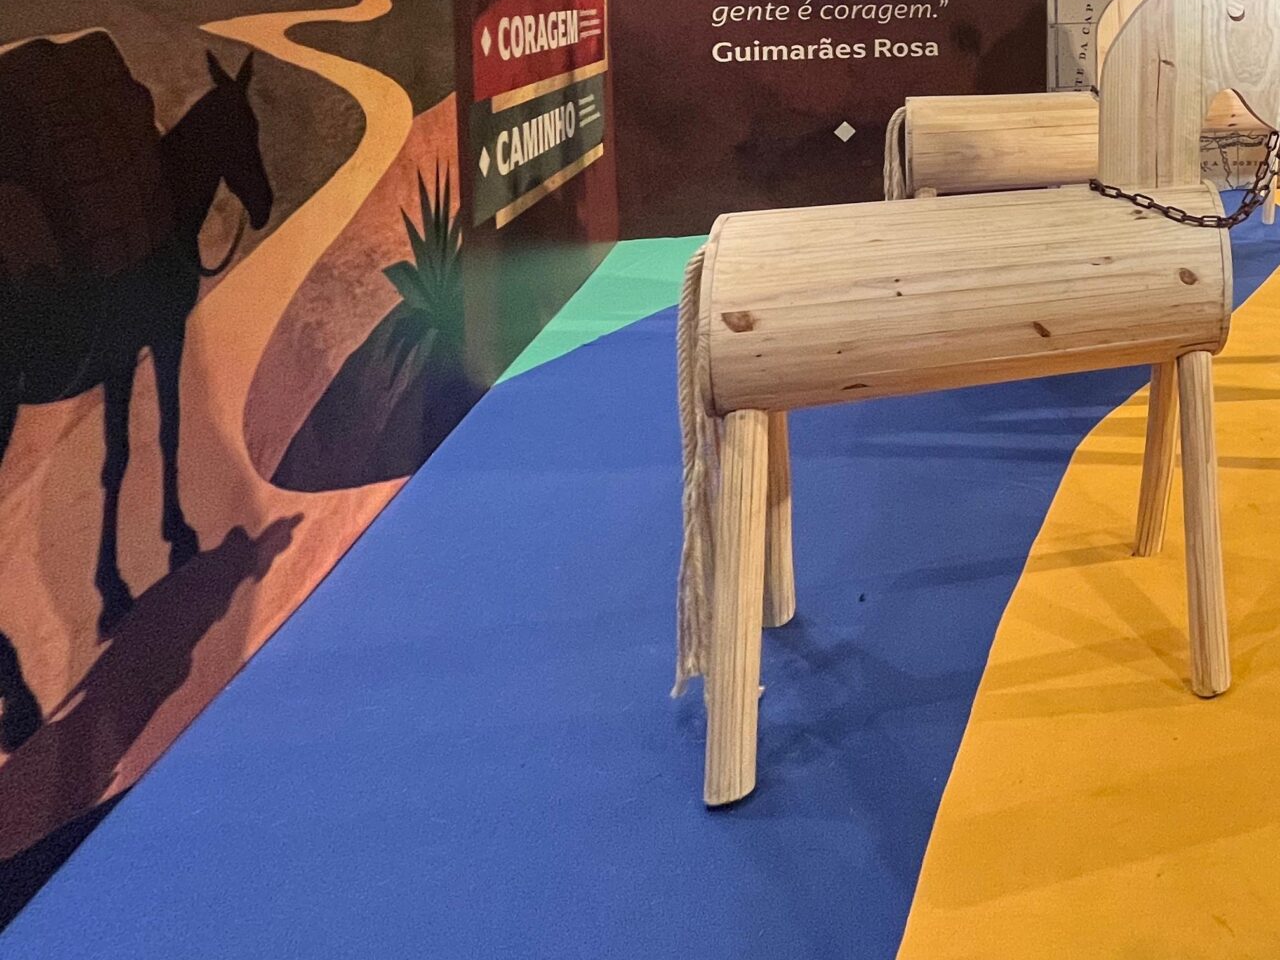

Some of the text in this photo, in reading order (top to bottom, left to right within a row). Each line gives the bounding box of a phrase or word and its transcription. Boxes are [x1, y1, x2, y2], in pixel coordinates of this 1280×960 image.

[711, 1, 790, 27] gente
[819, 0, 949, 24] coragem.”
[497, 9, 579, 61] CORAGEM
[711, 38, 939, 63] Guimarães Rosa
[496, 101, 576, 176] CAMINHO
